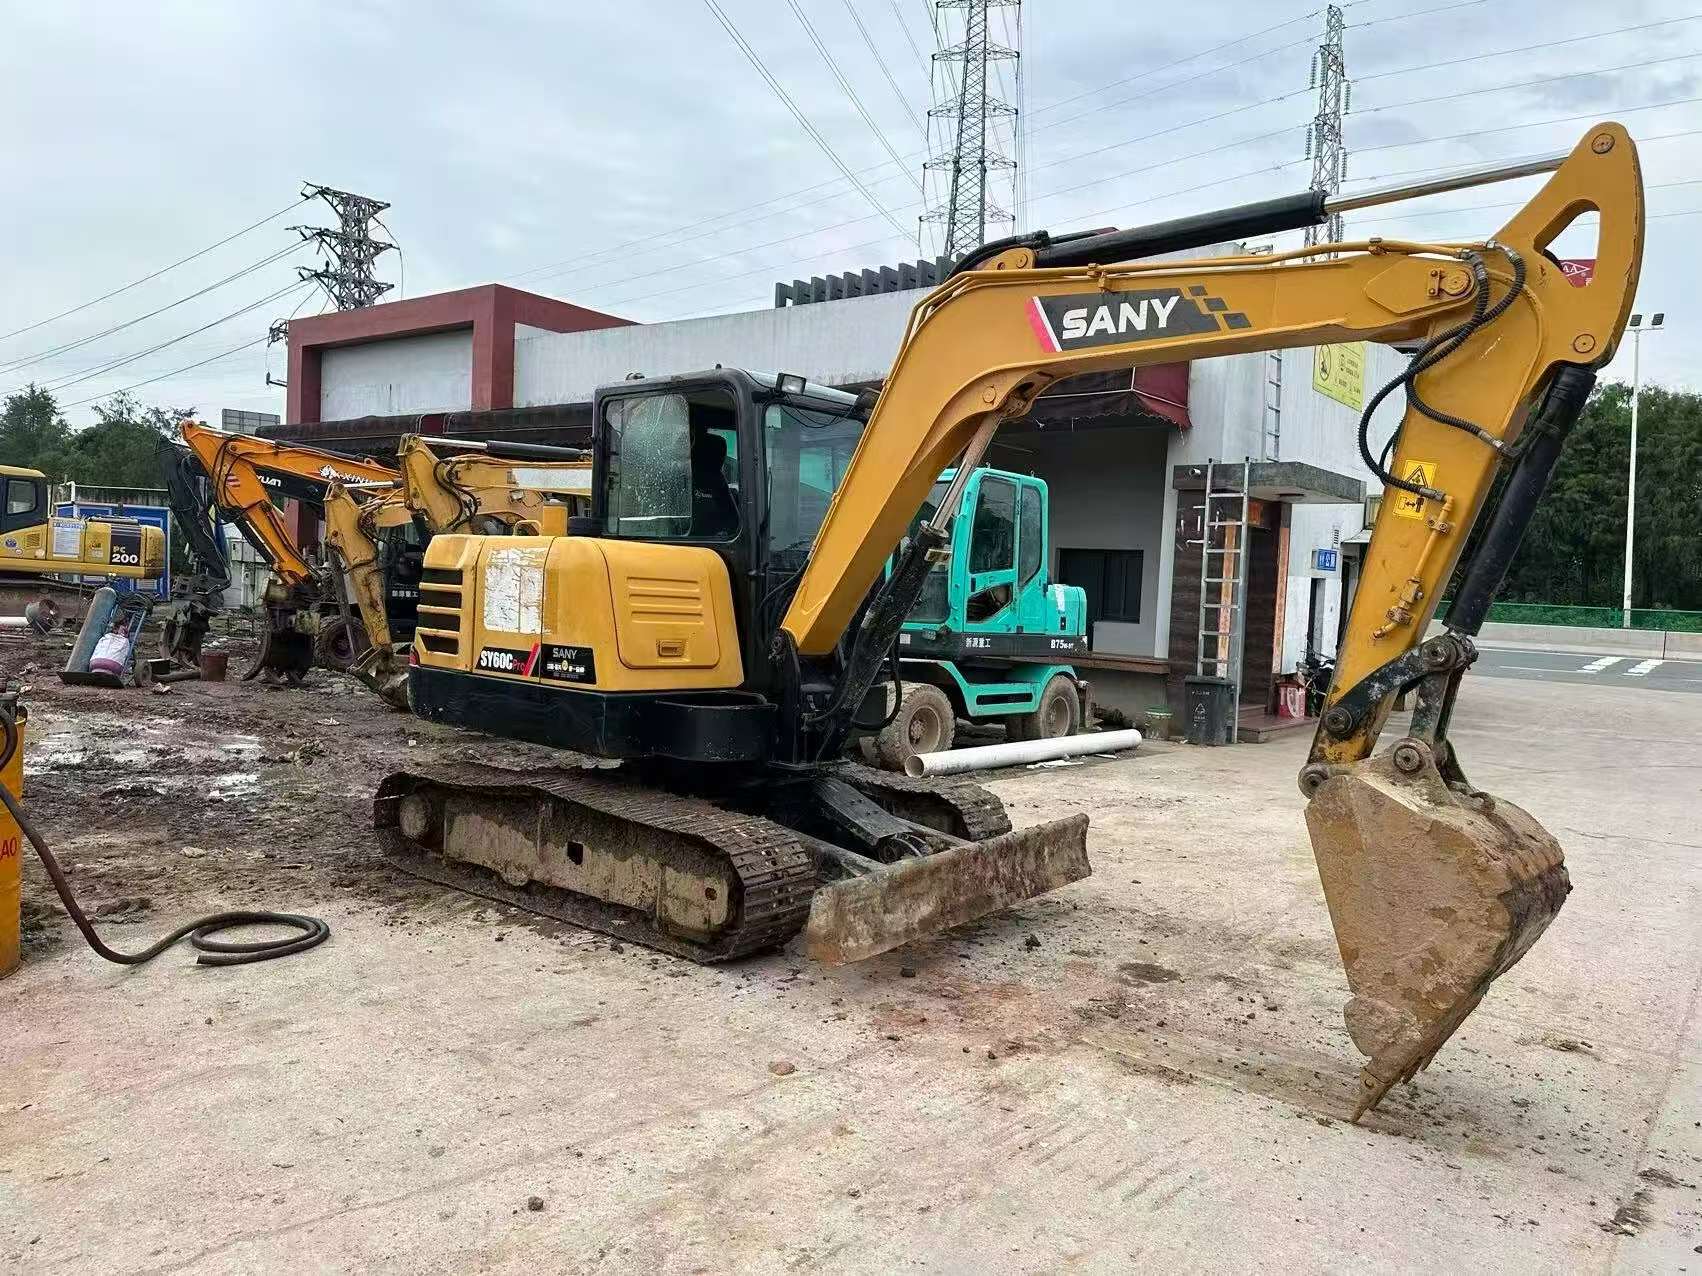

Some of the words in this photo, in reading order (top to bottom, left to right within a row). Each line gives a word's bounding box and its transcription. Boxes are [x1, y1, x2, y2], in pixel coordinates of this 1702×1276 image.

[1062, 296, 1180, 339] SANY
[113, 545, 127, 553] PC
[111, 553, 140, 565] 200
[552, 647, 578, 660] SANY
[479, 650, 514, 671] SY60C
